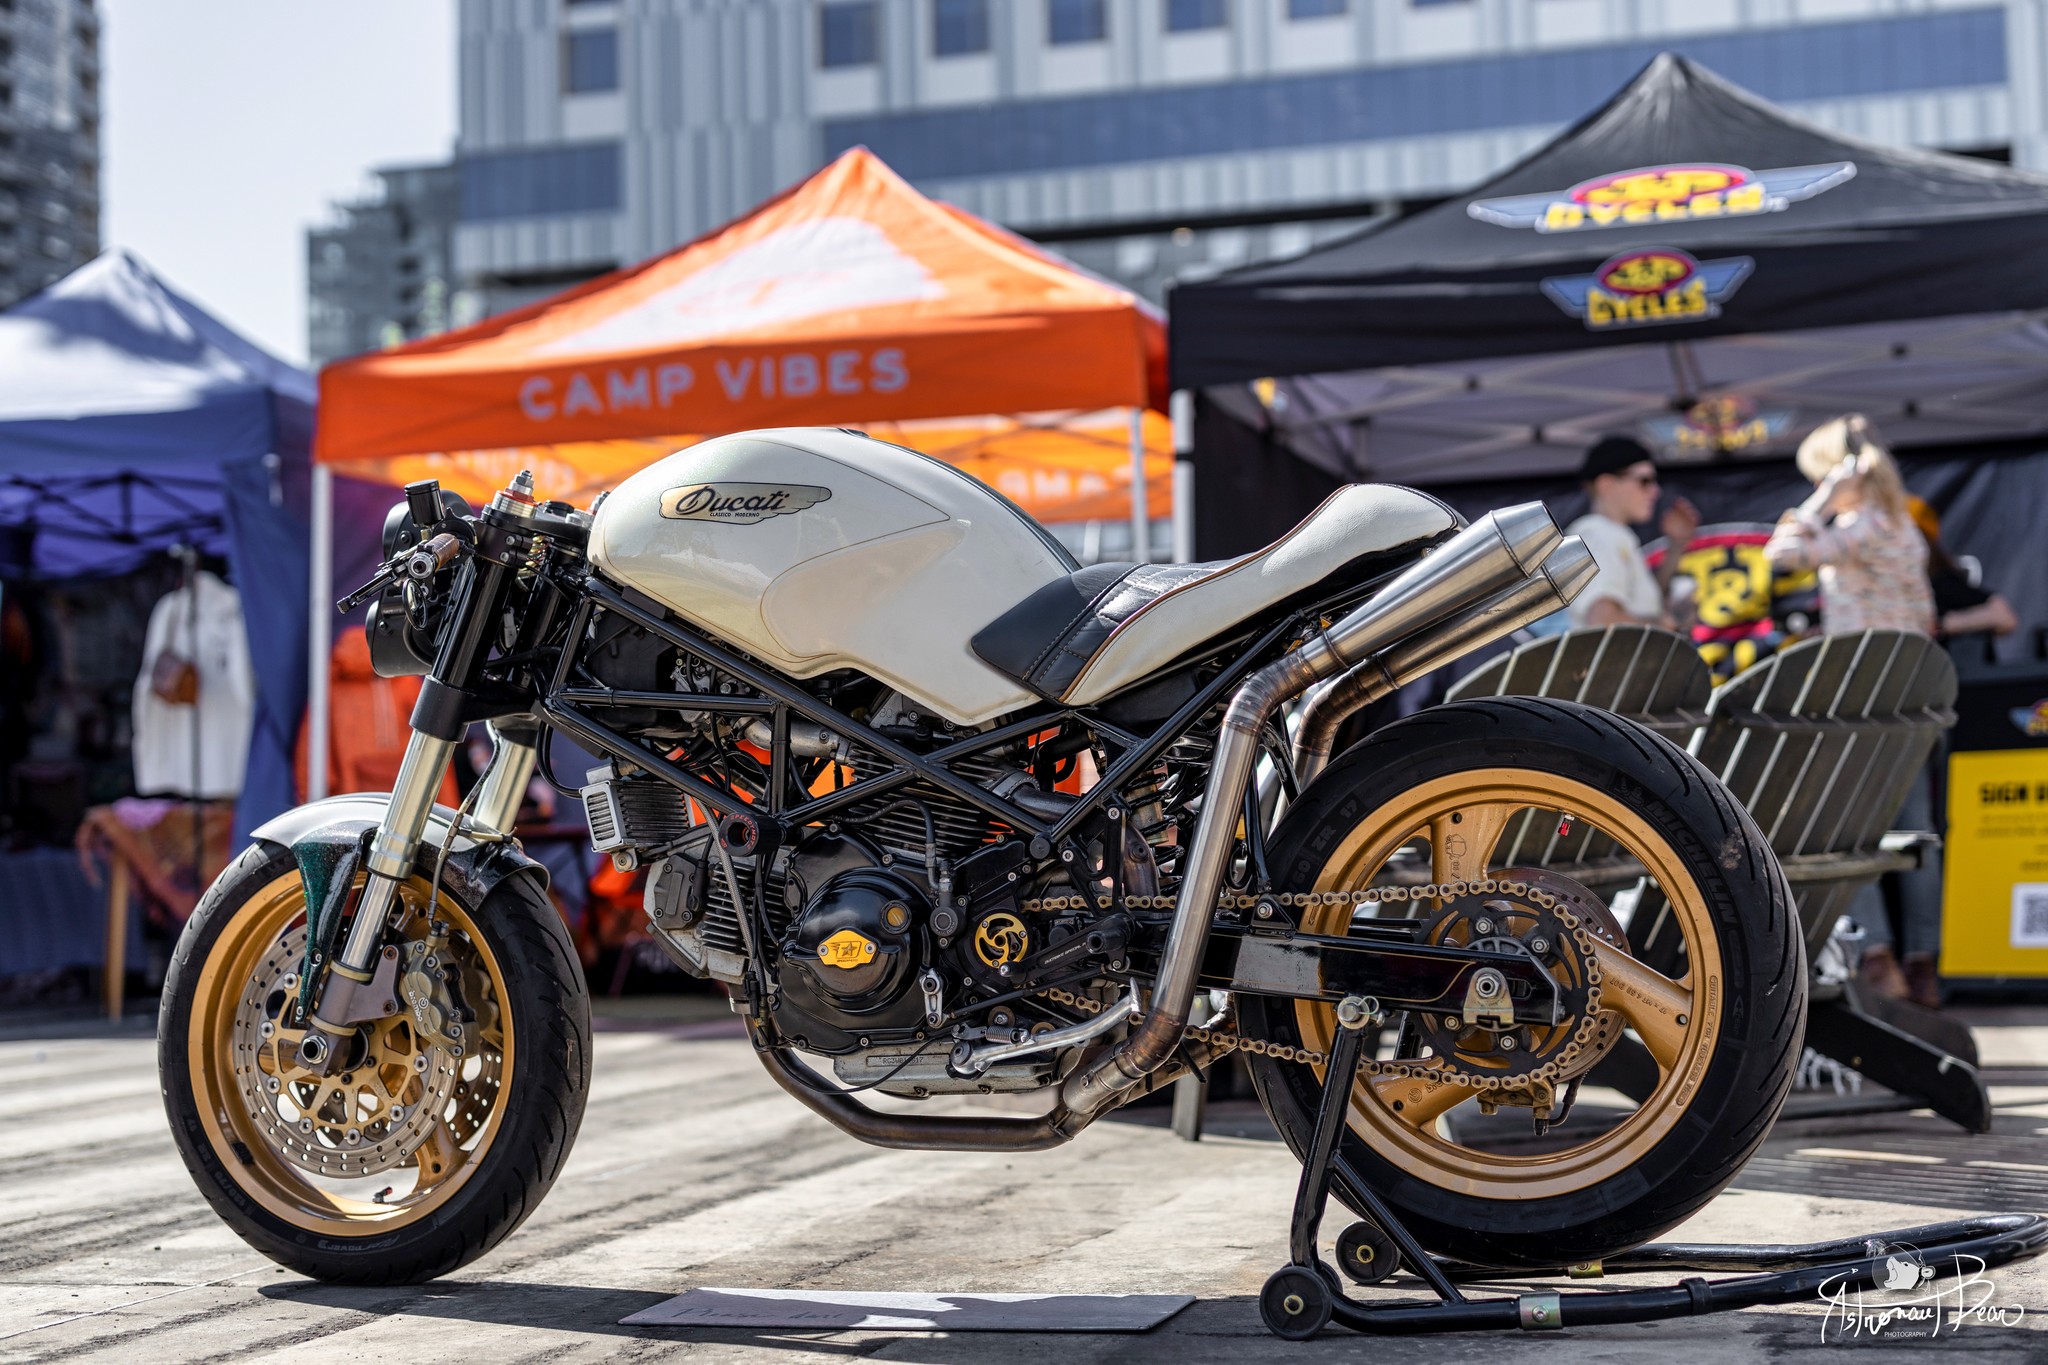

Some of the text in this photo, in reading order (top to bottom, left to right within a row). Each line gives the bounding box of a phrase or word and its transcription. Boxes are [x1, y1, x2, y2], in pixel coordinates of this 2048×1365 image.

[519, 347, 910, 421] CAMP VIBES
[675, 486, 790, 515] Ducati
[1648, 800, 1740, 926] MICHELIN
